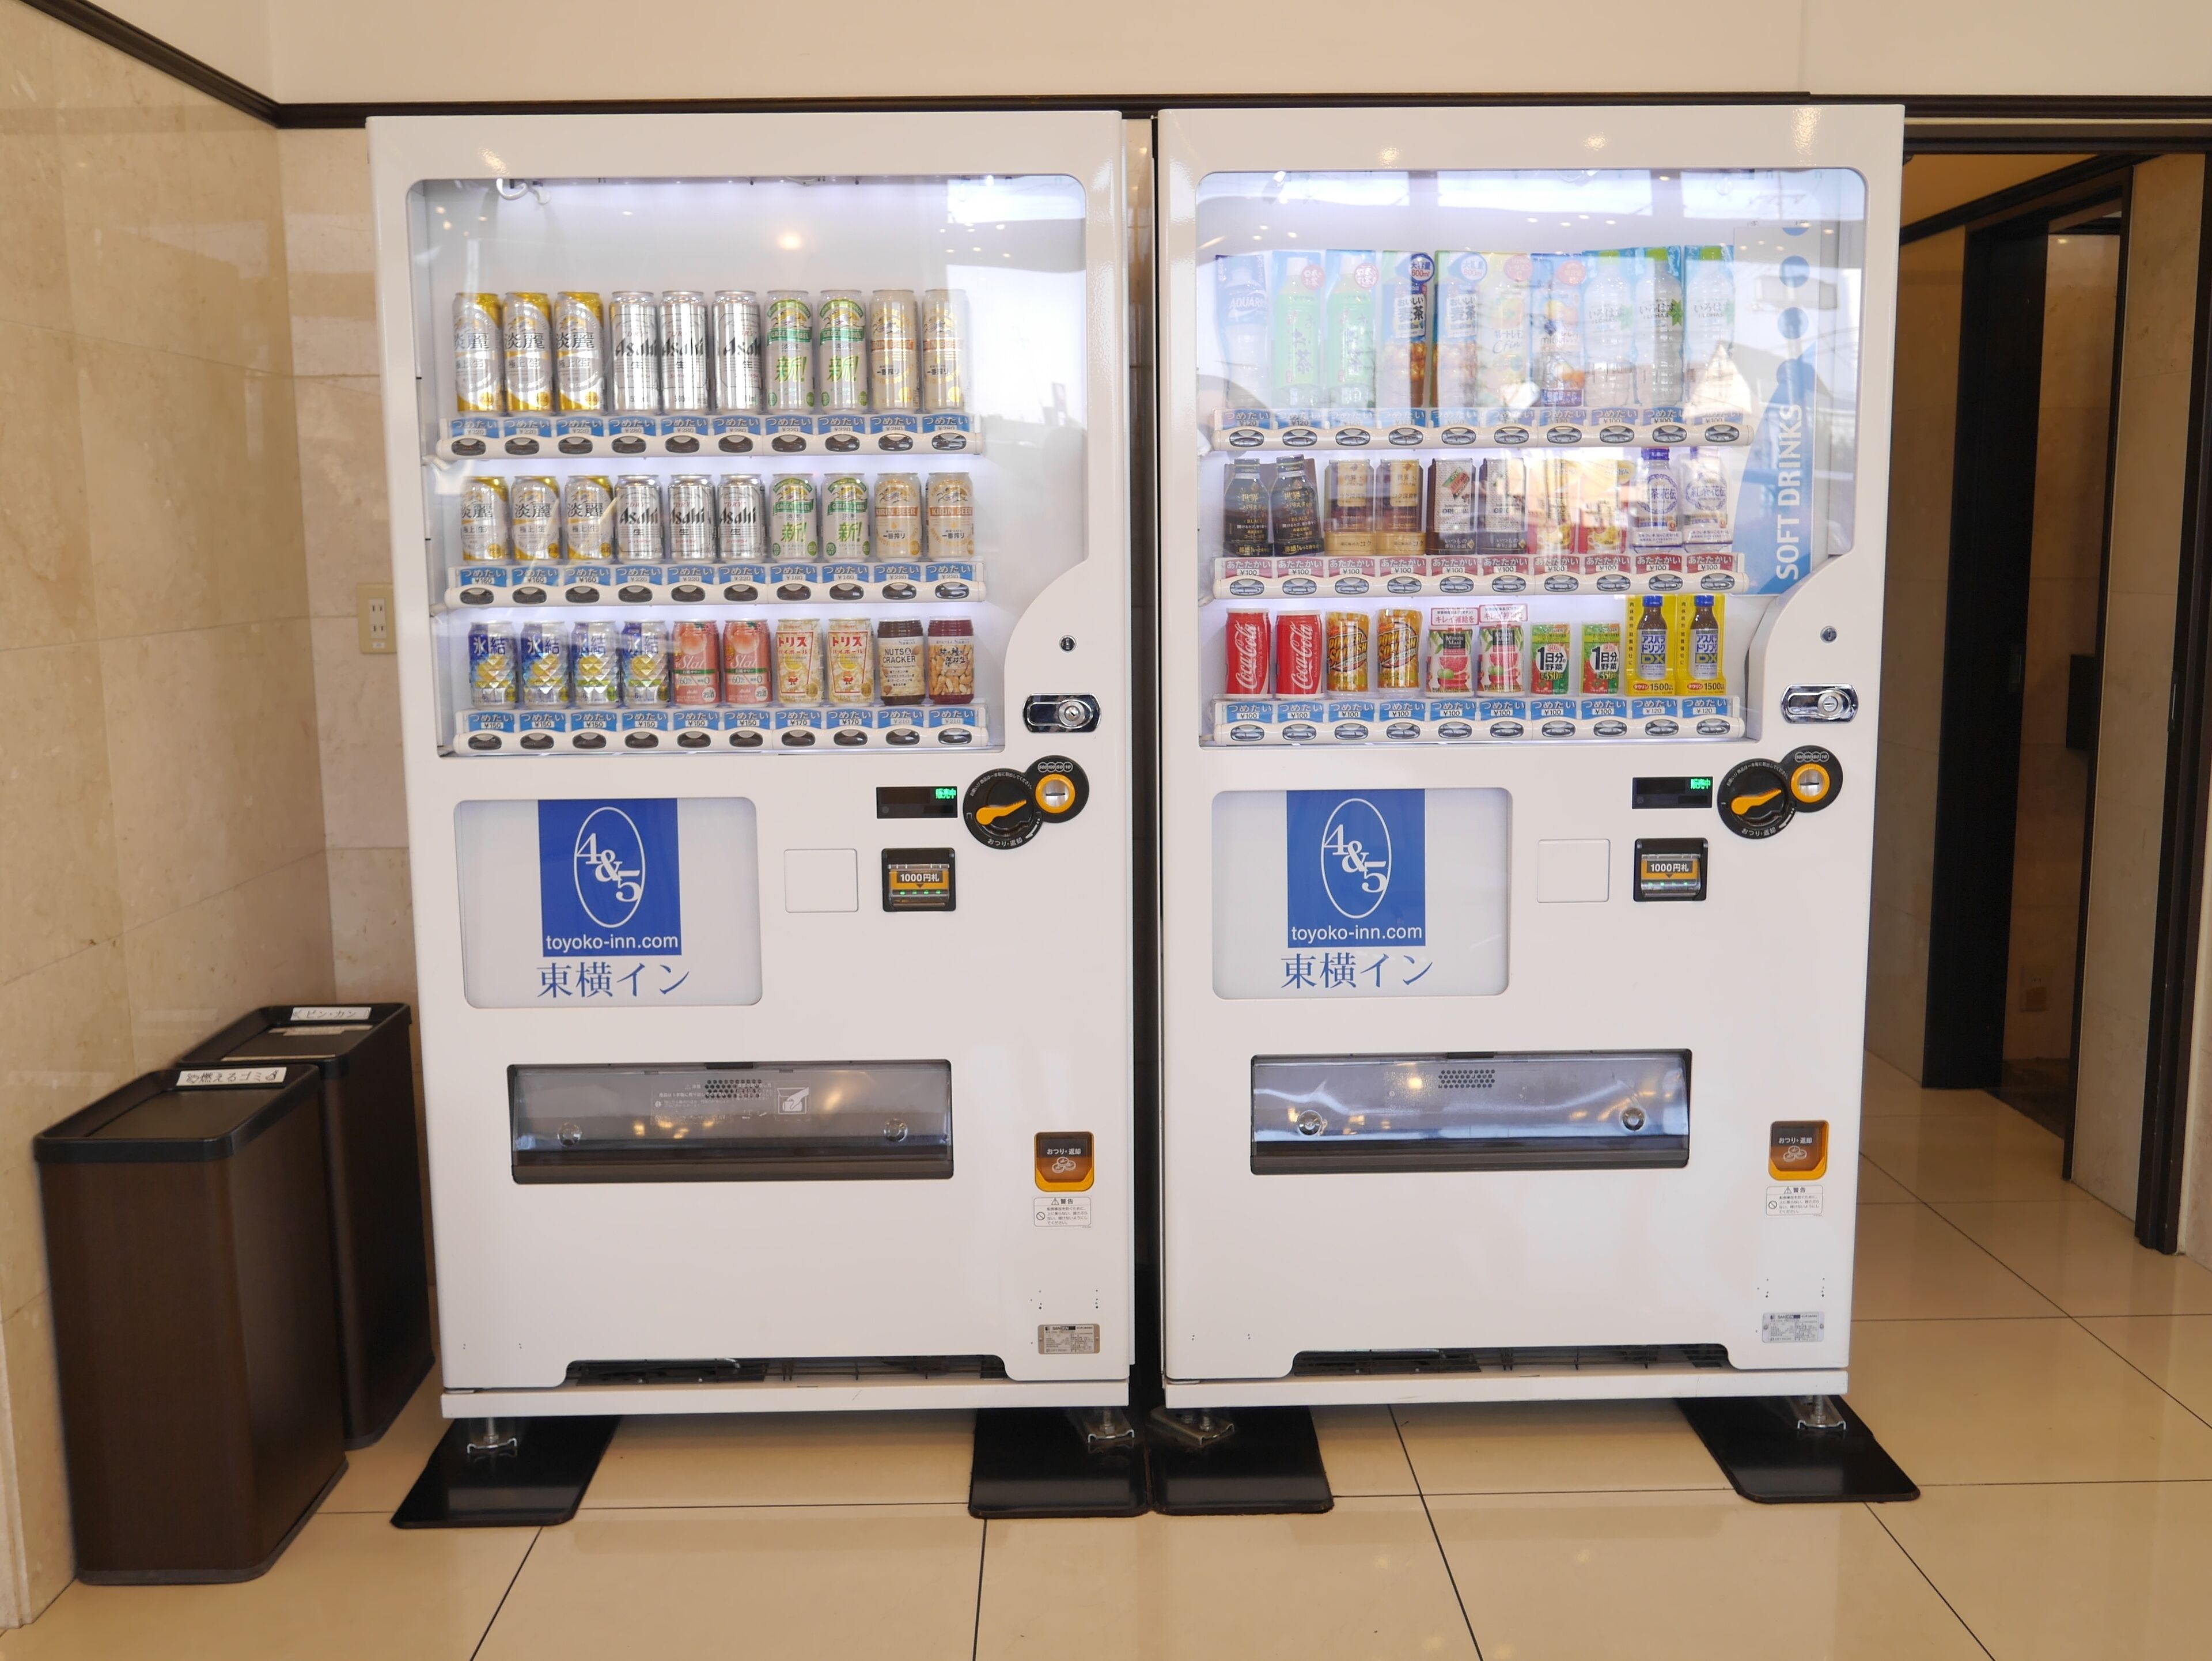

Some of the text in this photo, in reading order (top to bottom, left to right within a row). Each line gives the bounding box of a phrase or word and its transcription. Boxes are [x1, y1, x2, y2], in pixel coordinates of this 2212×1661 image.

[505, 332, 544, 349] 淡麗
[558, 332, 594, 349] 淡麗
[453, 419, 498, 428] つめたい
[610, 419, 654, 427] つめたい
[714, 418, 759, 427] つめたい
[767, 418, 812, 427] つめたい
[871, 417, 916, 425] つめたい
[1777, 405, 1802, 580] SOFT DRINKS
[515, 504, 550, 517] 淡麗
[567, 502, 603, 517] 淡麗
[620, 507, 658, 524] Asahi
[671, 507, 704, 524] Asahi
[720, 507, 756, 524] Asahi
[1330, 559, 1373, 567] あたたかい
[1433, 558, 1476, 566] あたたかい
[1586, 557, 1630, 565] あたたかい
[1688, 556, 1732, 564] あたたかい
[462, 569, 506, 577] つめたい
[617, 567, 661, 575] つめたい
[771, 566, 815, 574] つめたい
[474, 637, 505, 654] 氷結
[528, 635, 559, 654] 氷結
[779, 637, 807, 646] トリス
[833, 637, 862, 646] トリス
[1642, 644, 1665, 653] ドリンク
[1696, 644, 1717, 652] ドリンク
[1642, 654, 1664, 663] DX
[1696, 654, 1717, 663] DX
[1331, 703, 1373, 712] つめたい
[1532, 701, 1575, 709] つめたい
[1634, 700, 1676, 708] つめたい
[1691, 779, 1711, 790] 販売中
[935, 789, 956, 799] 販売中
[1741, 827, 1776, 837] おつり・返却
[987, 837, 1023, 847] おつり・返却
[1650, 864, 1688, 872] 1000円札
[900, 873, 940, 883] 1000円札
[1291, 925, 1422, 944] toyoko-inn.com
[546, 934, 678, 952] toyoko-inn.com
[1281, 952, 1433, 988] 東横イン
[536, 962, 690, 998] 東横イン
[306, 1010, 357, 1019] ビン・カン
[200, 1072, 261, 1083] 燃えるゴミ
